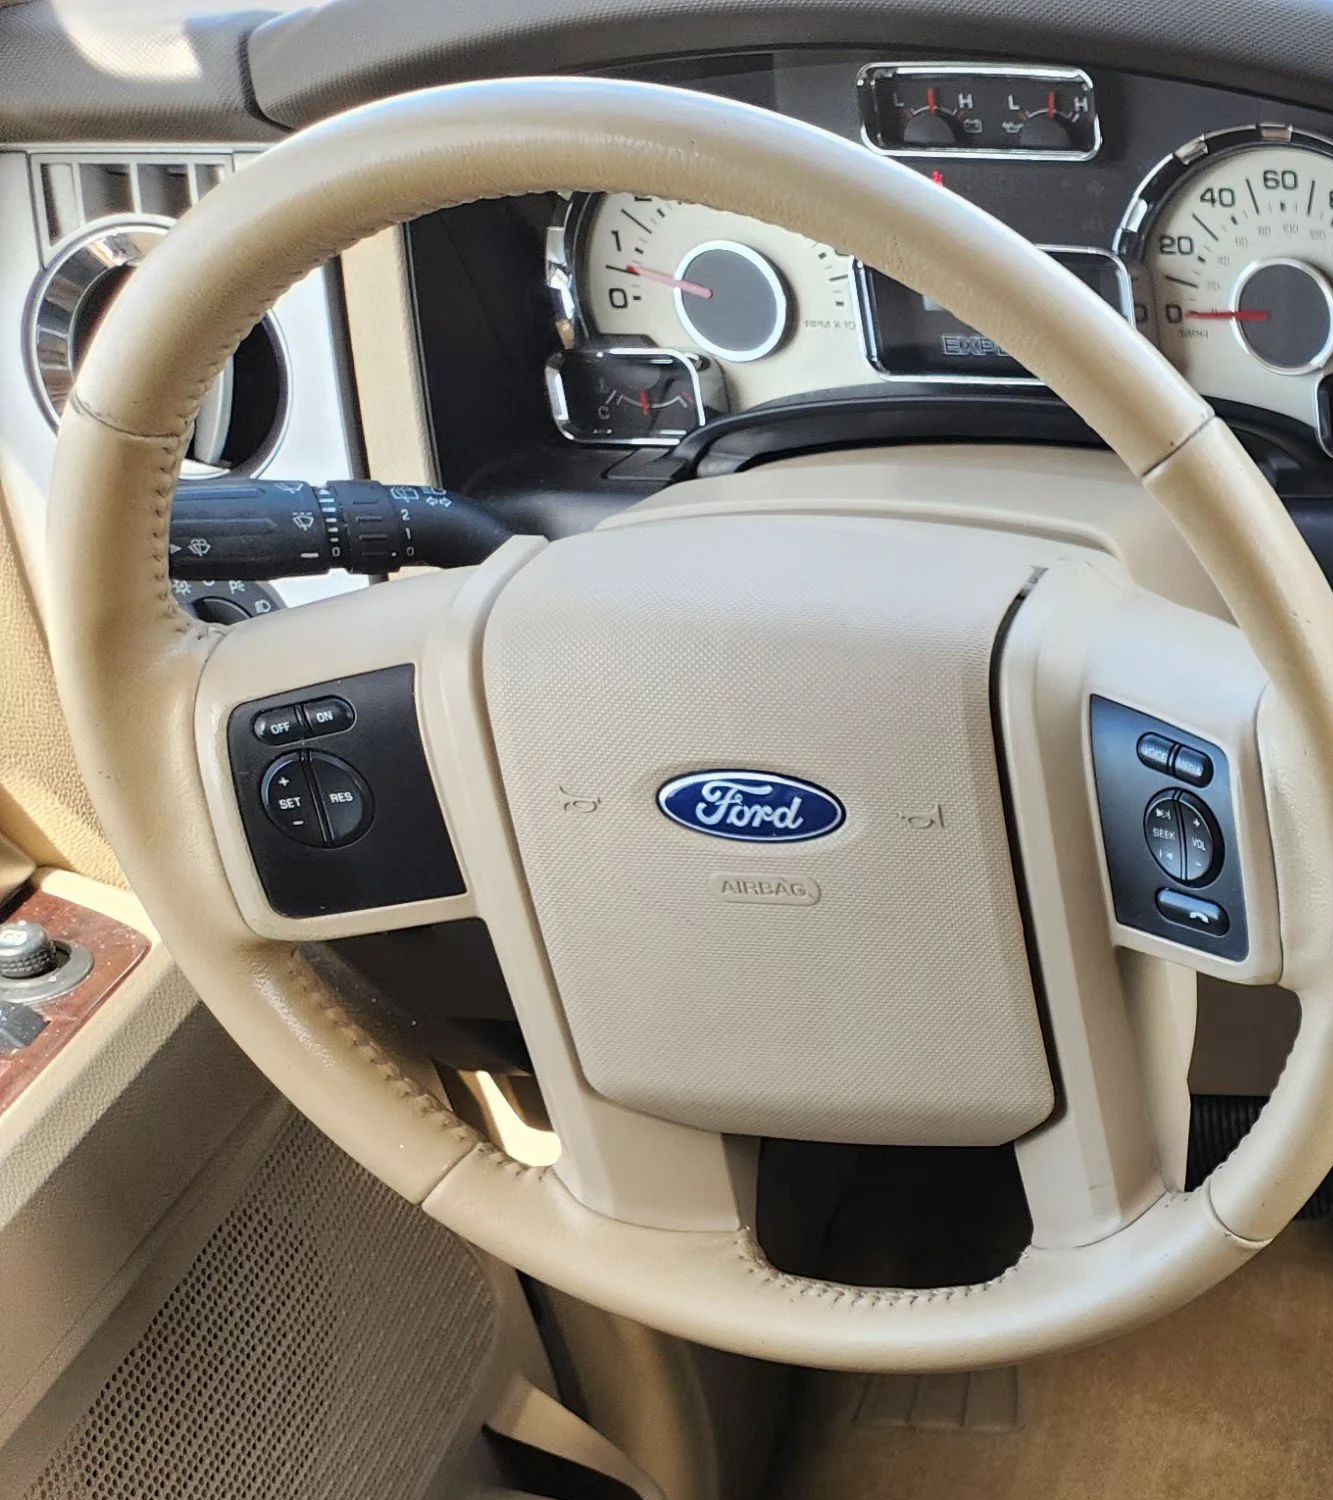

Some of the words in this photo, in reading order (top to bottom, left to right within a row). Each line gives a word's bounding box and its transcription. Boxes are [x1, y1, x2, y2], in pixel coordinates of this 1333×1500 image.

[958, 93, 973, 109] H
[1008, 94, 1020, 110] L
[1074, 97, 1089, 112] H
[1263, 170, 1299, 190] 60
[1200, 187, 1236, 208] 40
[611, 230, 622, 251] 1
[1159, 235, 1195, 256] 20
[608, 287, 628, 309] 0
[1165, 303, 1183, 324] 0
[401, 508, 411, 521] 2
[316, 710, 334, 723] ON
[271, 721, 291, 735] OFF
[278, 796, 301, 810] SET
[329, 792, 353, 804] RES
[695, 780, 805, 829] Ford
[1152, 827, 1175, 841] SEEK
[1191, 838, 1206, 851] VOL
[720, 878, 809, 897] AIRBAG
